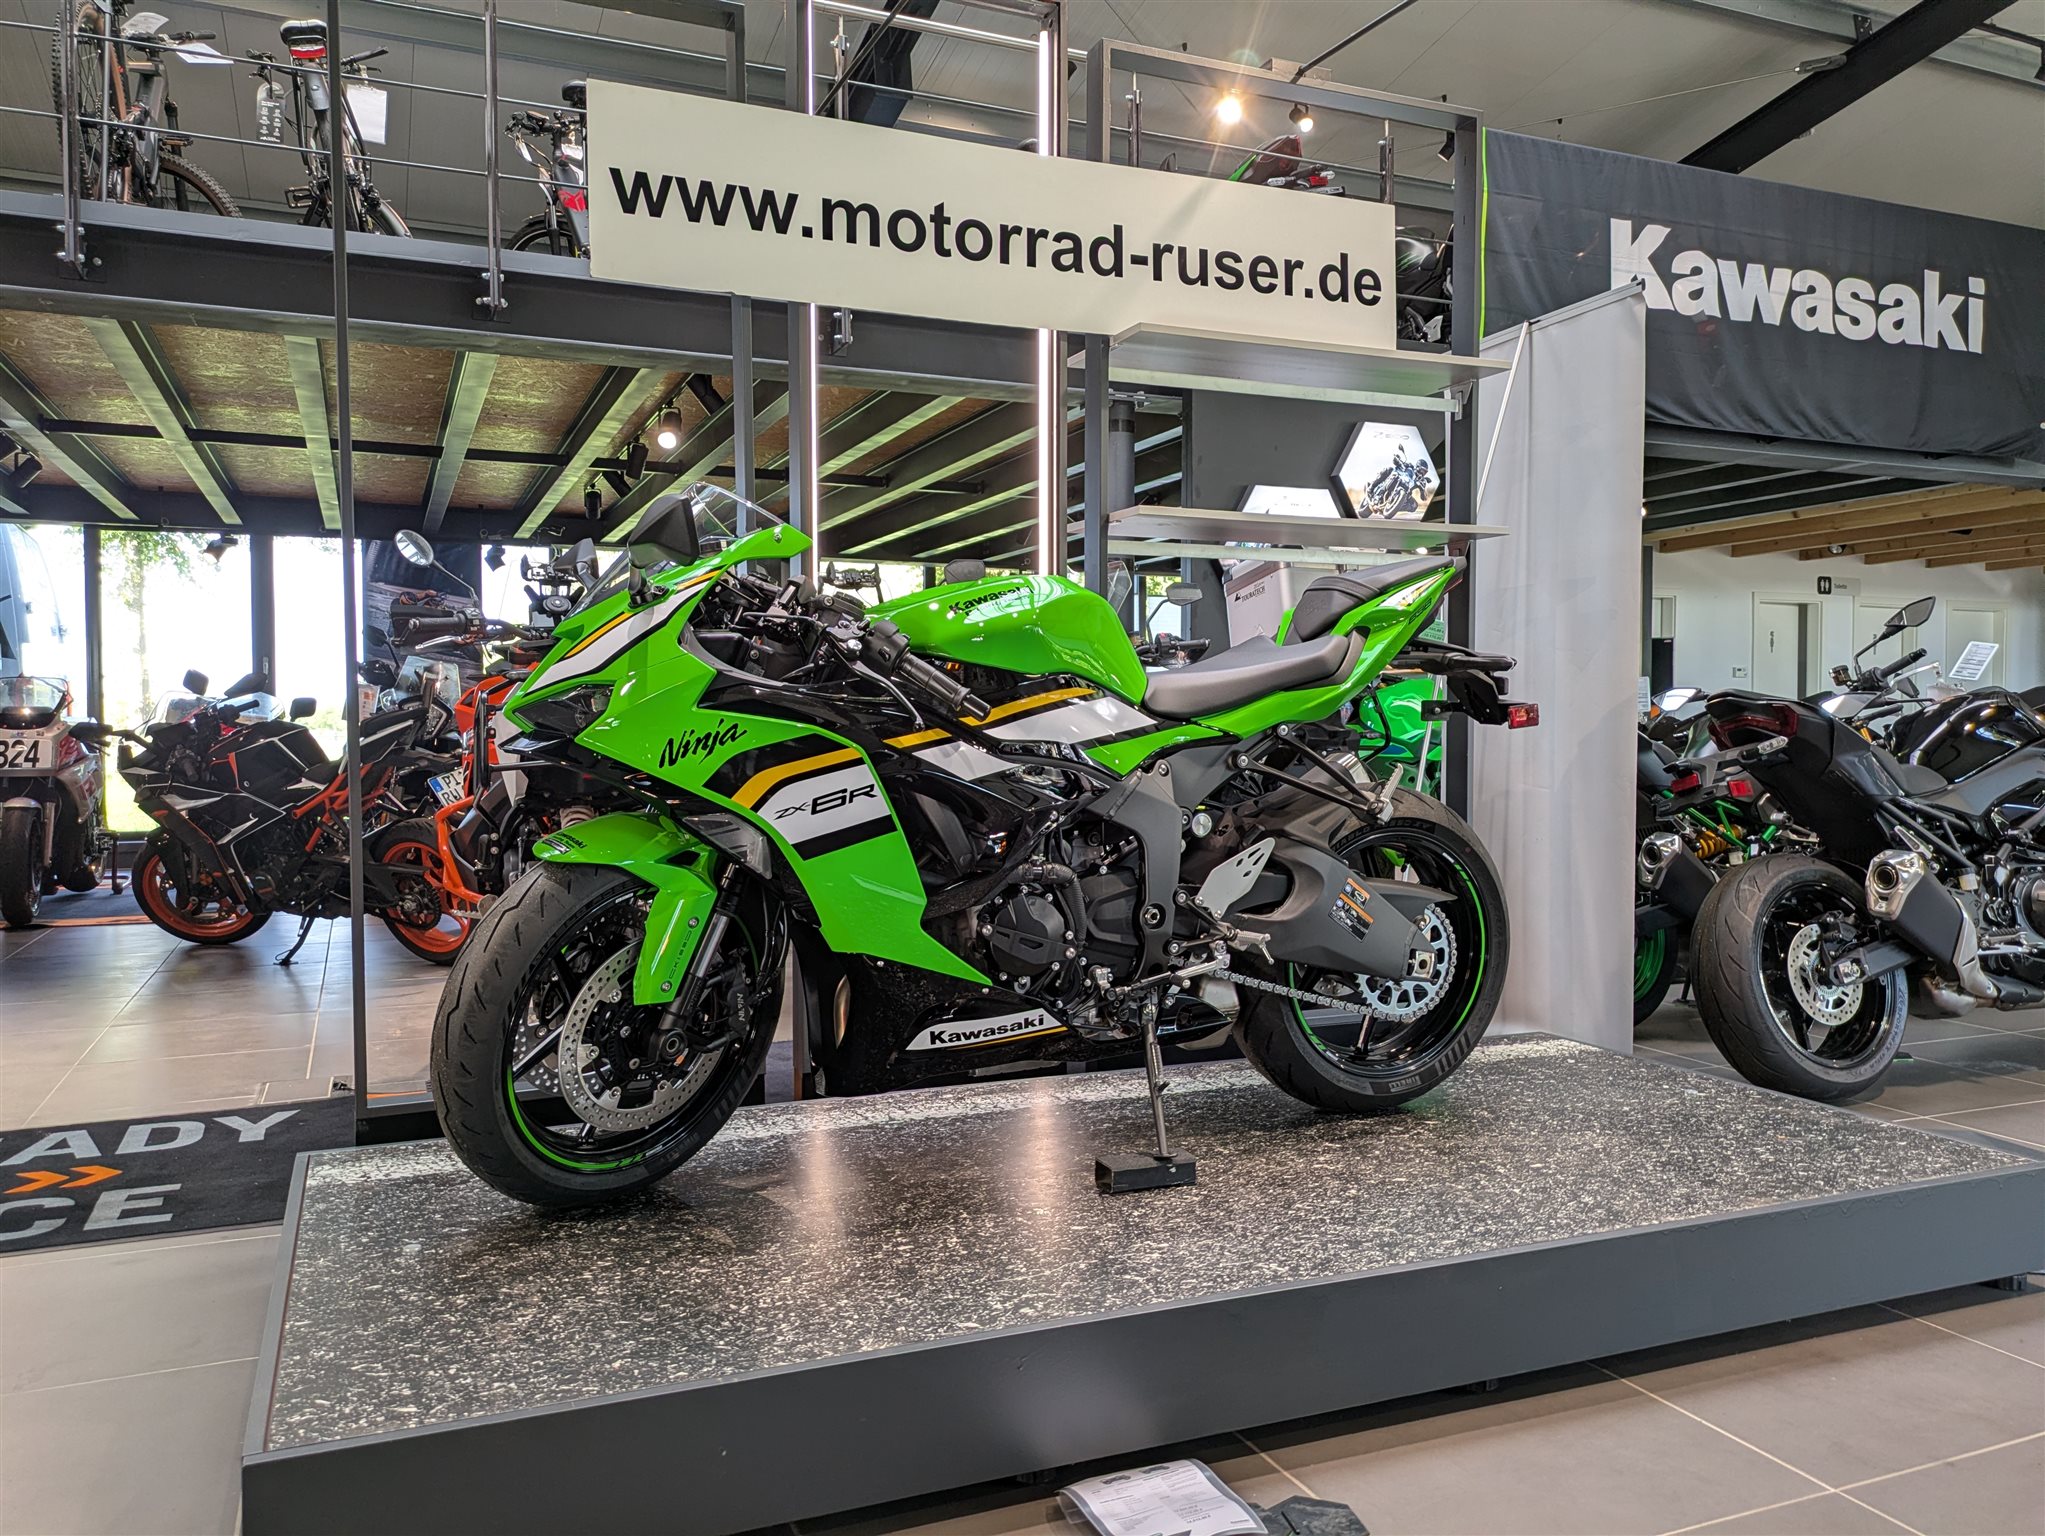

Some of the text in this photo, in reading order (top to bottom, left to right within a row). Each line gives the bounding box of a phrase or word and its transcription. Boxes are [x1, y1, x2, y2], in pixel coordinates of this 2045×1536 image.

[608, 166, 1383, 307] www.motorrad-ruser.de
[1609, 217, 1986, 355] Kawasaki
[658, 718, 748, 769] Ninja
[773, 784, 878, 821] ZX-6R
[929, 1014, 1045, 1046] Kawasaki
[0, 1109, 301, 1167] ADY
